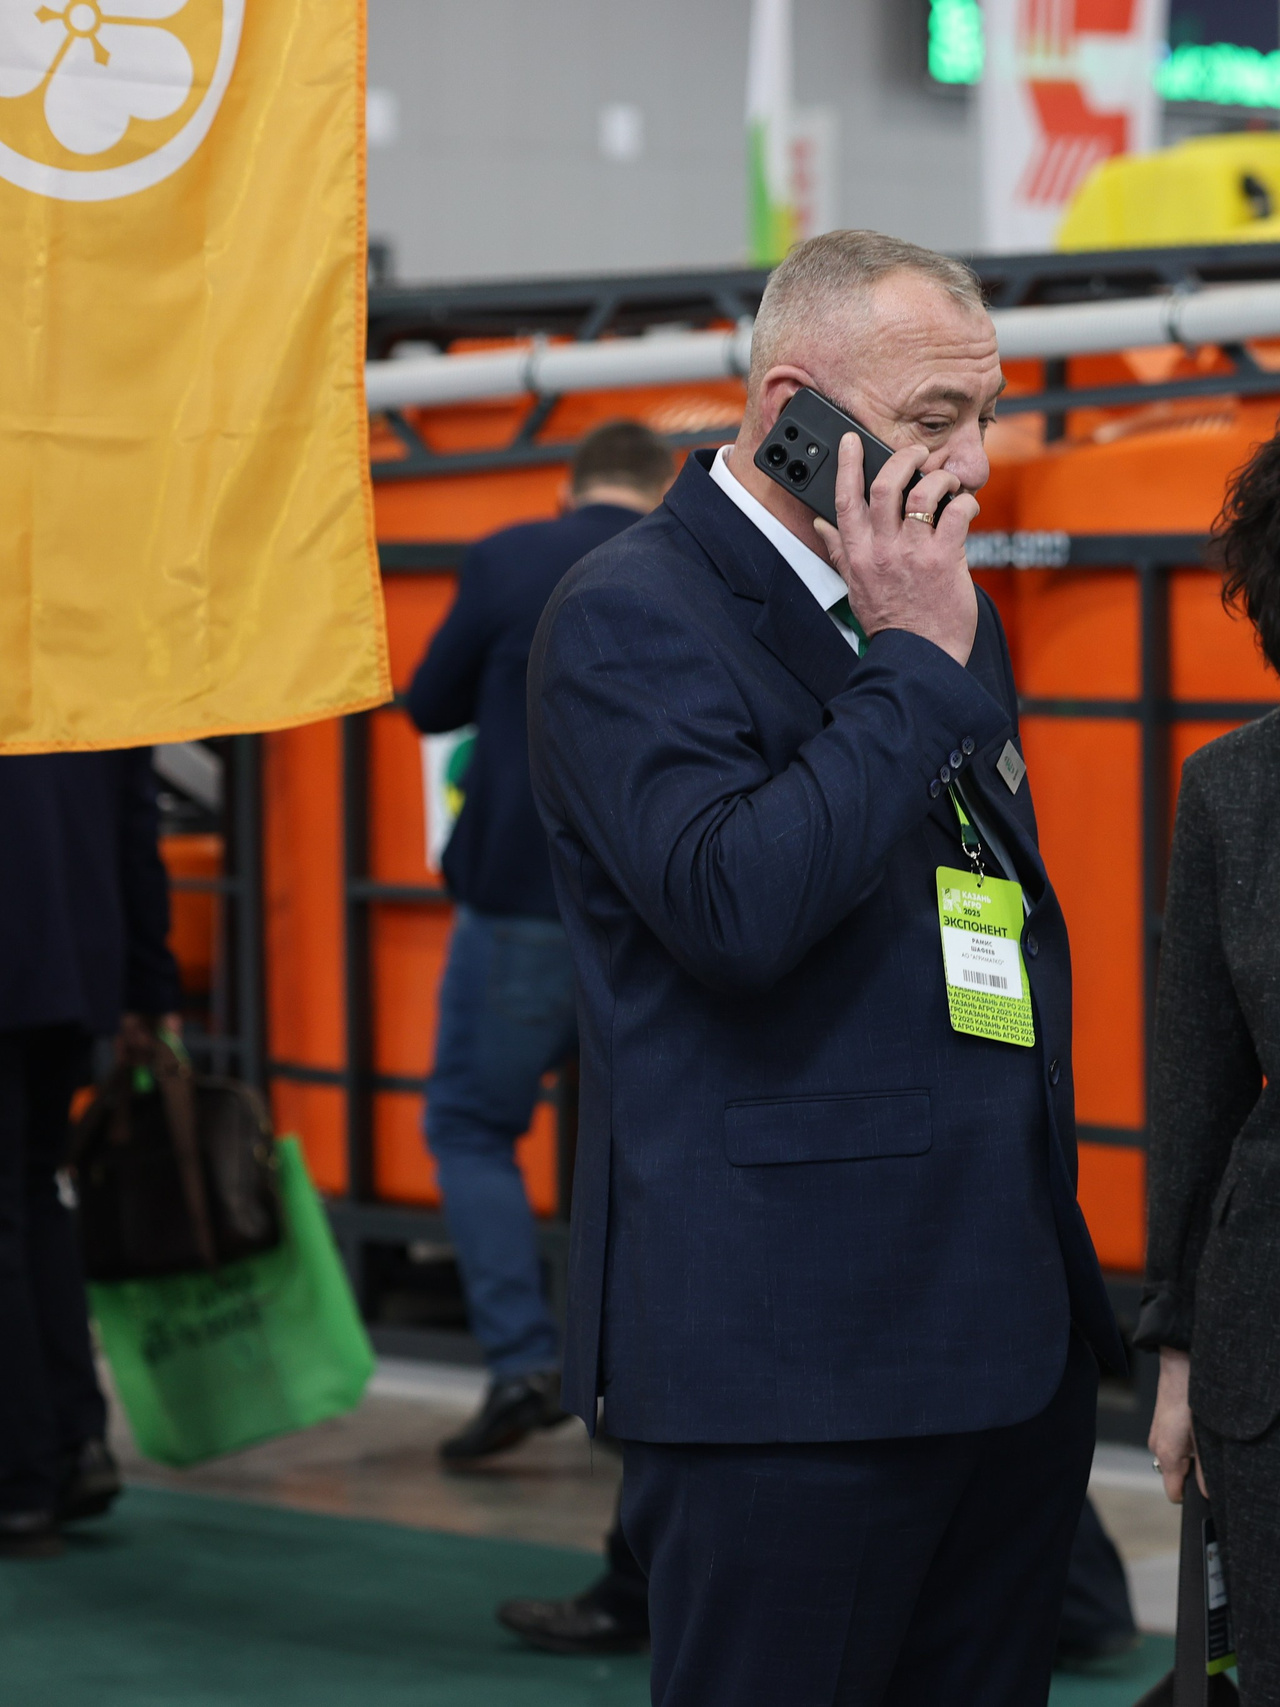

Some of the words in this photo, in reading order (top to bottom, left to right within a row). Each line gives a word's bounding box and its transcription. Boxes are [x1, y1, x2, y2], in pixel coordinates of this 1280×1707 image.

[962, 891, 992, 904] КАЗАНЬ
[963, 900, 982, 909] АГРО
[964, 908, 981, 917] 2025
[943, 916, 1008, 938] ЭКСПОНЕНТ
[972, 995, 997, 1006] КАЗАНЬ
[964, 1008, 990, 1020] КАЗАНЬ
[992, 1014, 1009, 1023] АГРО
[978, 1004, 996, 1013] АГРО
[996, 1008, 1012, 1016] 2025
[958, 1015, 974, 1024] 2025
[974, 1018, 1001, 1029] КАЗАНЬ
[1002, 1024, 1020, 1033] АГРО
[958, 1023, 974, 1032] АГРО
[976, 1026, 1002, 1037] КАЗАНЬ
[1003, 1032, 1020, 1042] АГРО
